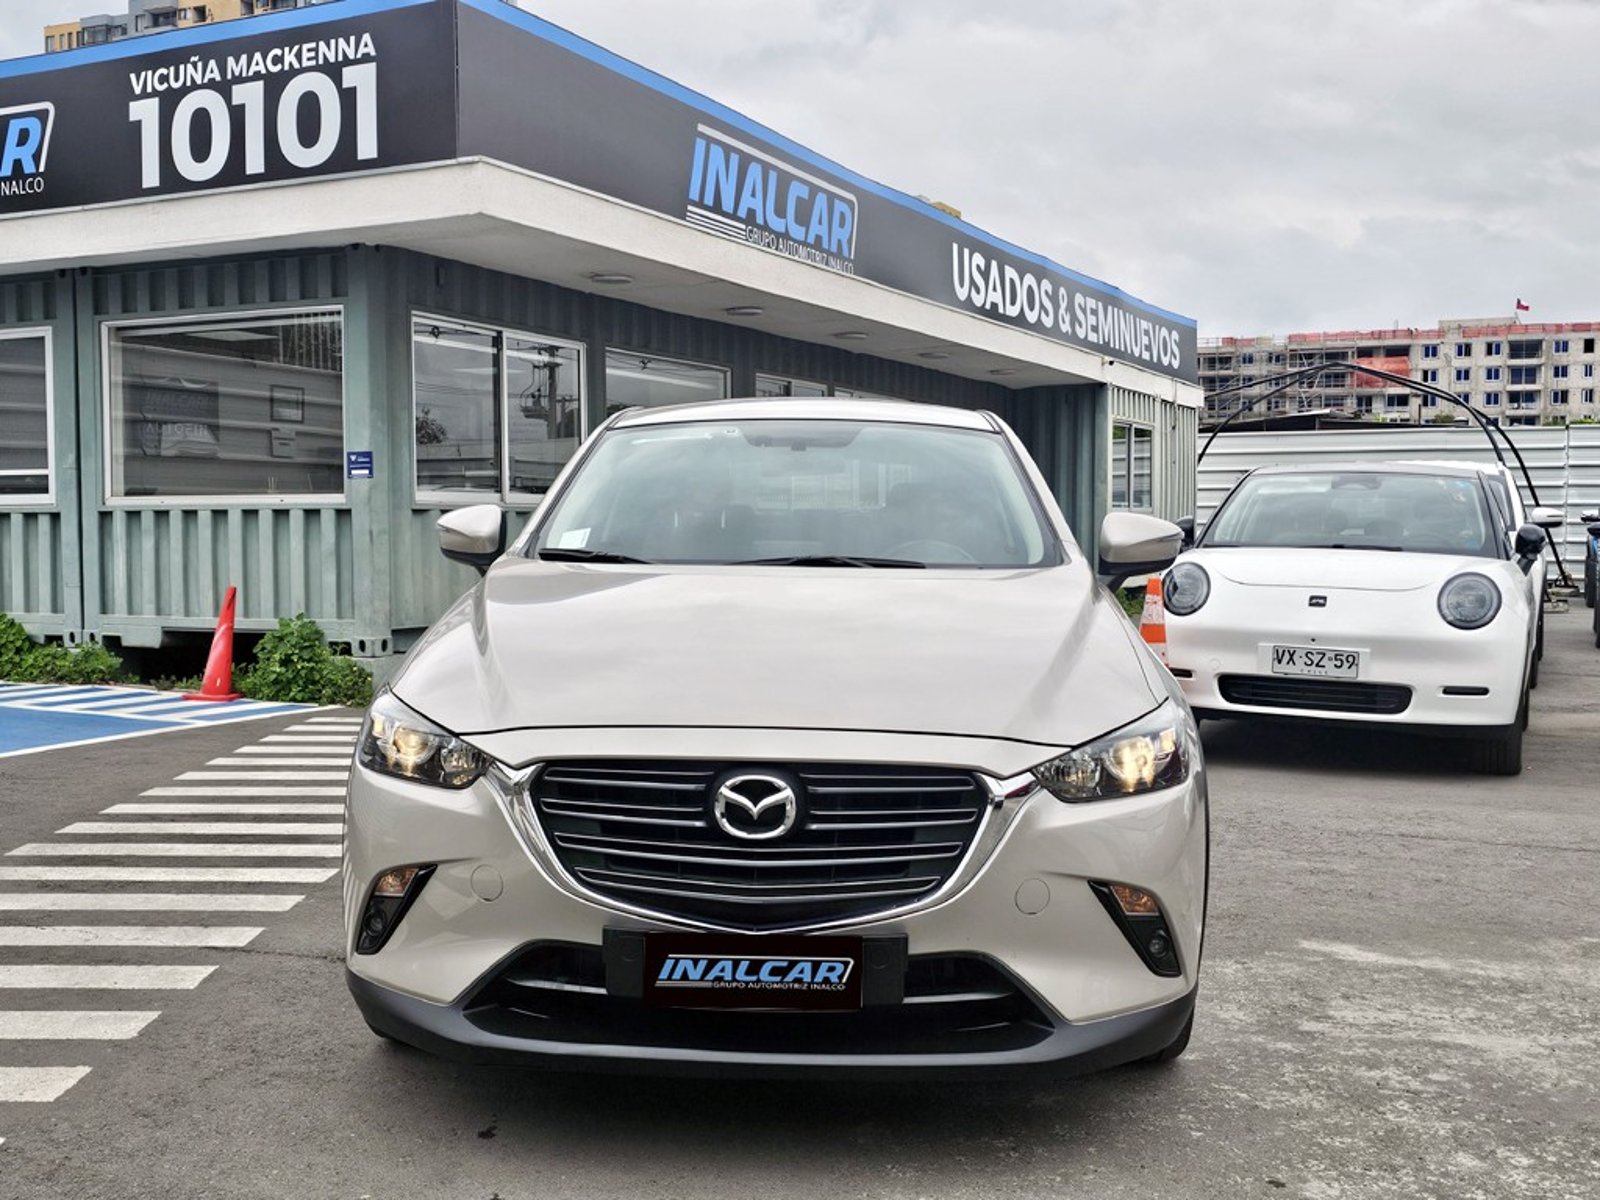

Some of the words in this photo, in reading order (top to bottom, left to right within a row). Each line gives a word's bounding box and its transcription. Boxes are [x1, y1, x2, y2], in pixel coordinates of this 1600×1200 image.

[129, 55, 221, 95] VICUÑA
[226, 32, 377, 79] MACKENNA
[129, 61, 378, 189] 10101
[688, 137, 853, 259] INALCAR
[746, 226, 777, 250] GRUPO
[777, 238, 828, 266] AUTOMOTRIZ
[952, 242, 1054, 329] USADOS
[1058, 286, 1072, 336] &
[1074, 291, 1181, 370] SEMINUEVOS
[658, 959, 845, 983] INALCAR
[713, 981, 746, 990] GRUPO
[748, 981, 809, 991] AUTOMOTRIZ
[810, 983, 846, 992] INALCO
